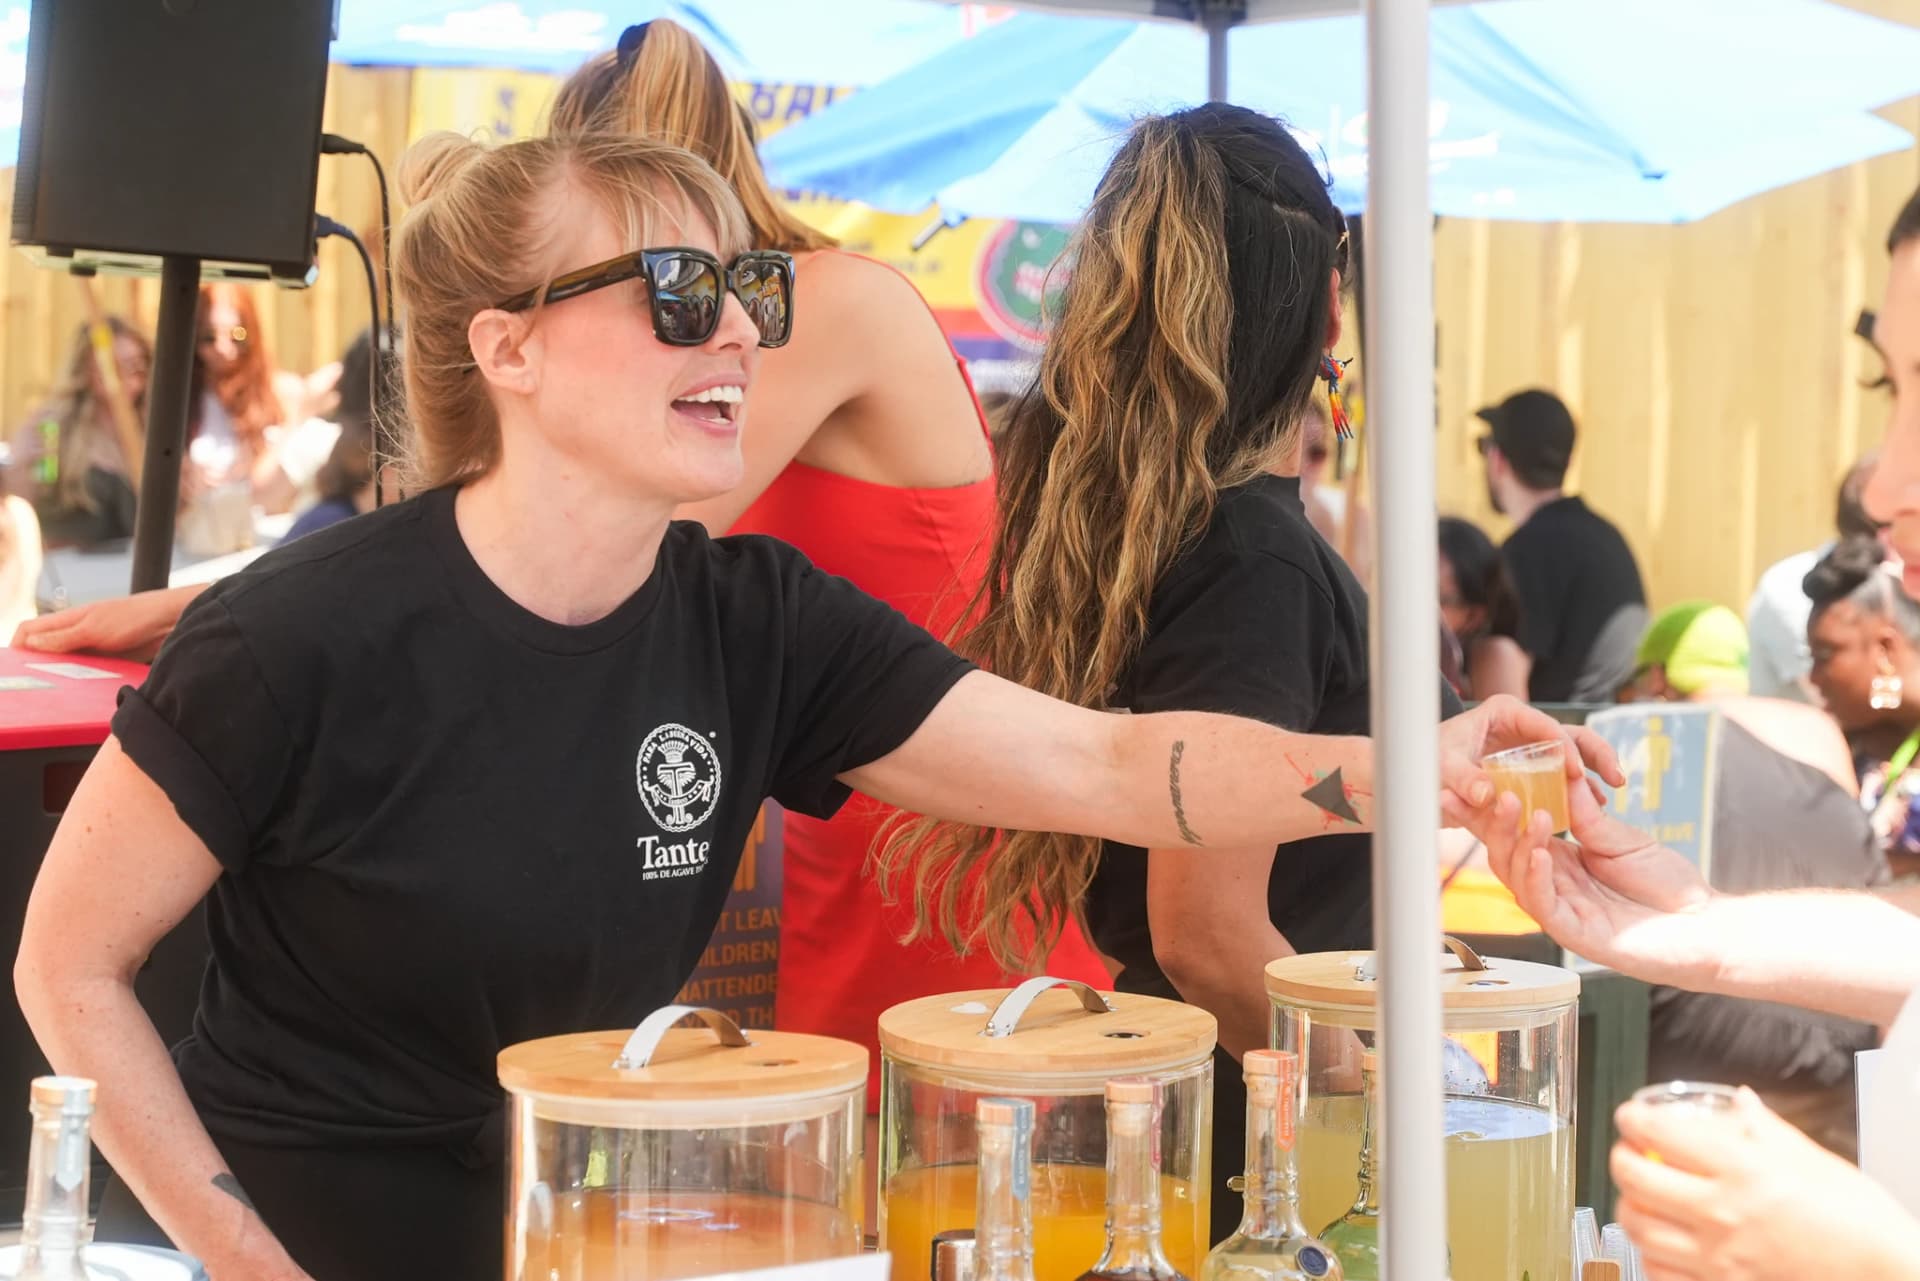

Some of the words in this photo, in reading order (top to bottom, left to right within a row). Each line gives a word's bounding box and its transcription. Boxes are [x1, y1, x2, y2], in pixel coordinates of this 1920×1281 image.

[642, 742, 658, 764] PARA
[689, 738, 709, 761] VIDA
[636, 835, 710, 869] Tante
[660, 869, 670, 879] DE
[671, 867, 694, 877] AGAVE
